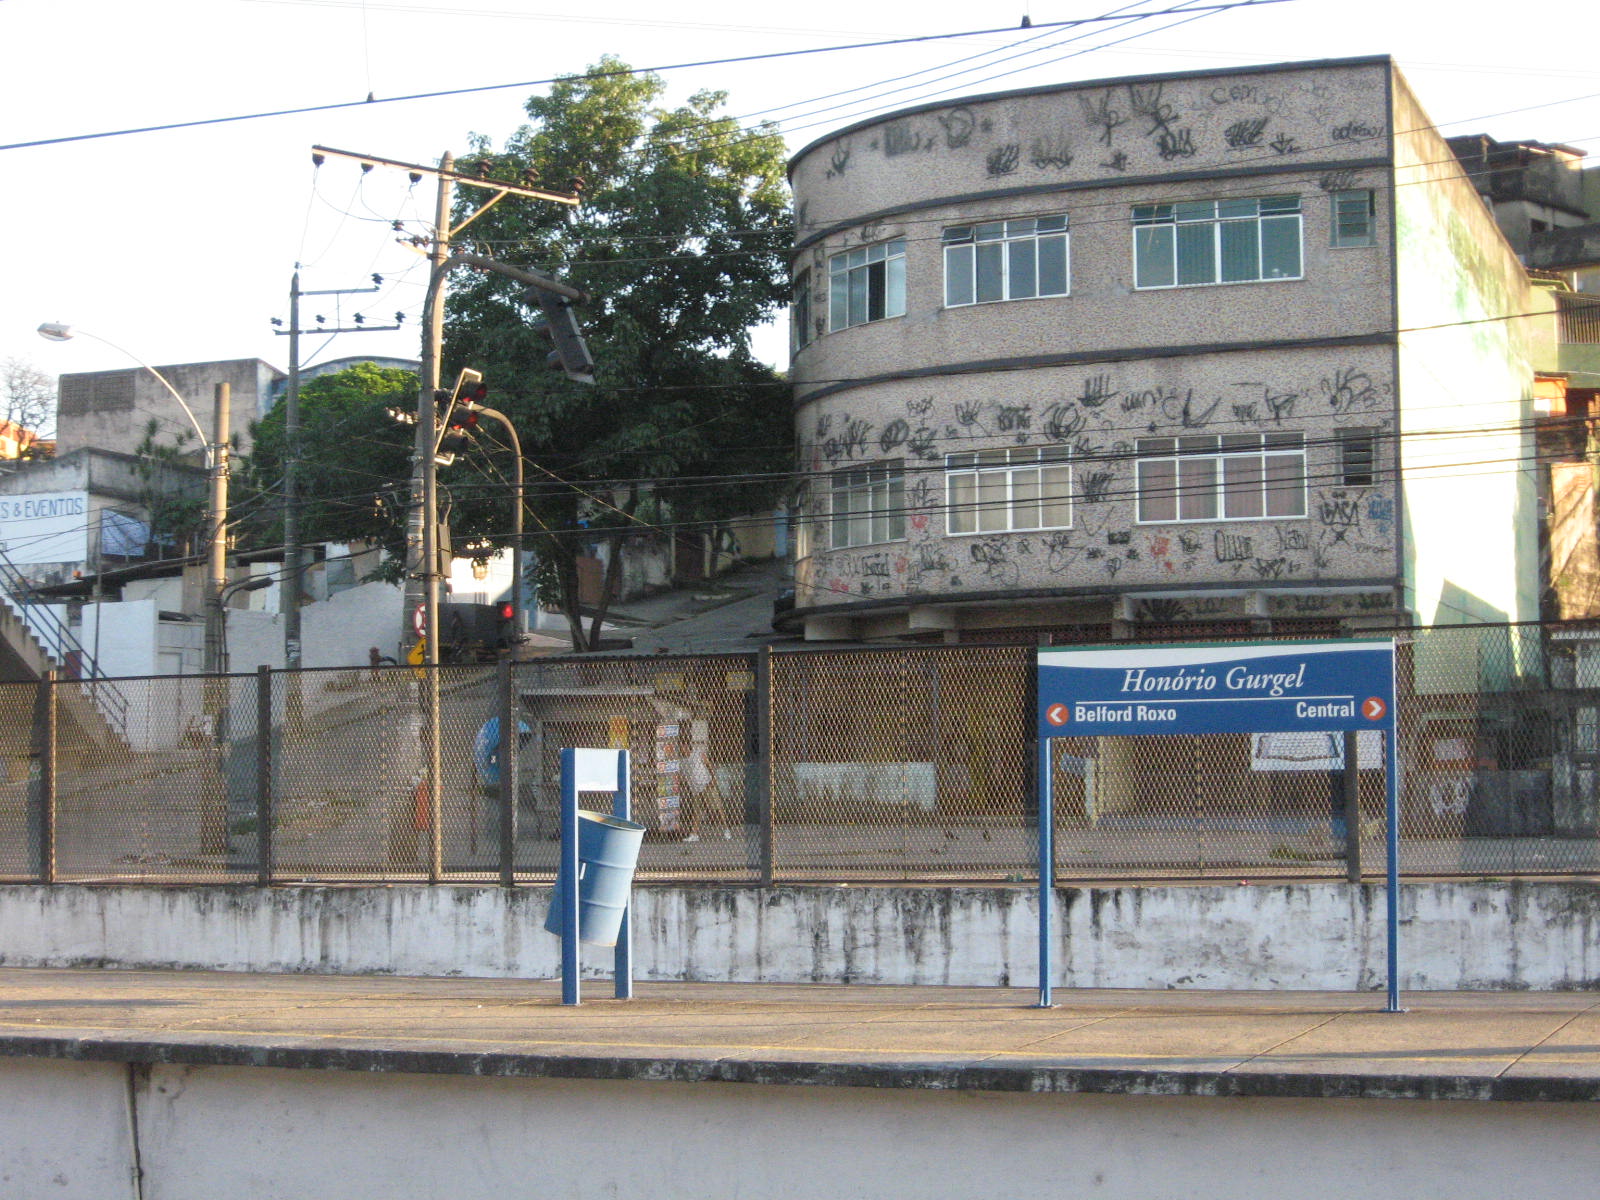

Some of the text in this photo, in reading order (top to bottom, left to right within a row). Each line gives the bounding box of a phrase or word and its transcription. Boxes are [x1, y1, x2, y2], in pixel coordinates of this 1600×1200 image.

[14, 503, 21, 517] &
[25, 497, 83, 518] EVENTOS
[1120, 663, 1306, 696] Honório Gurgel
[1075, 705, 1177, 723] Belford Roxo
[1296, 700, 1355, 719] Central
